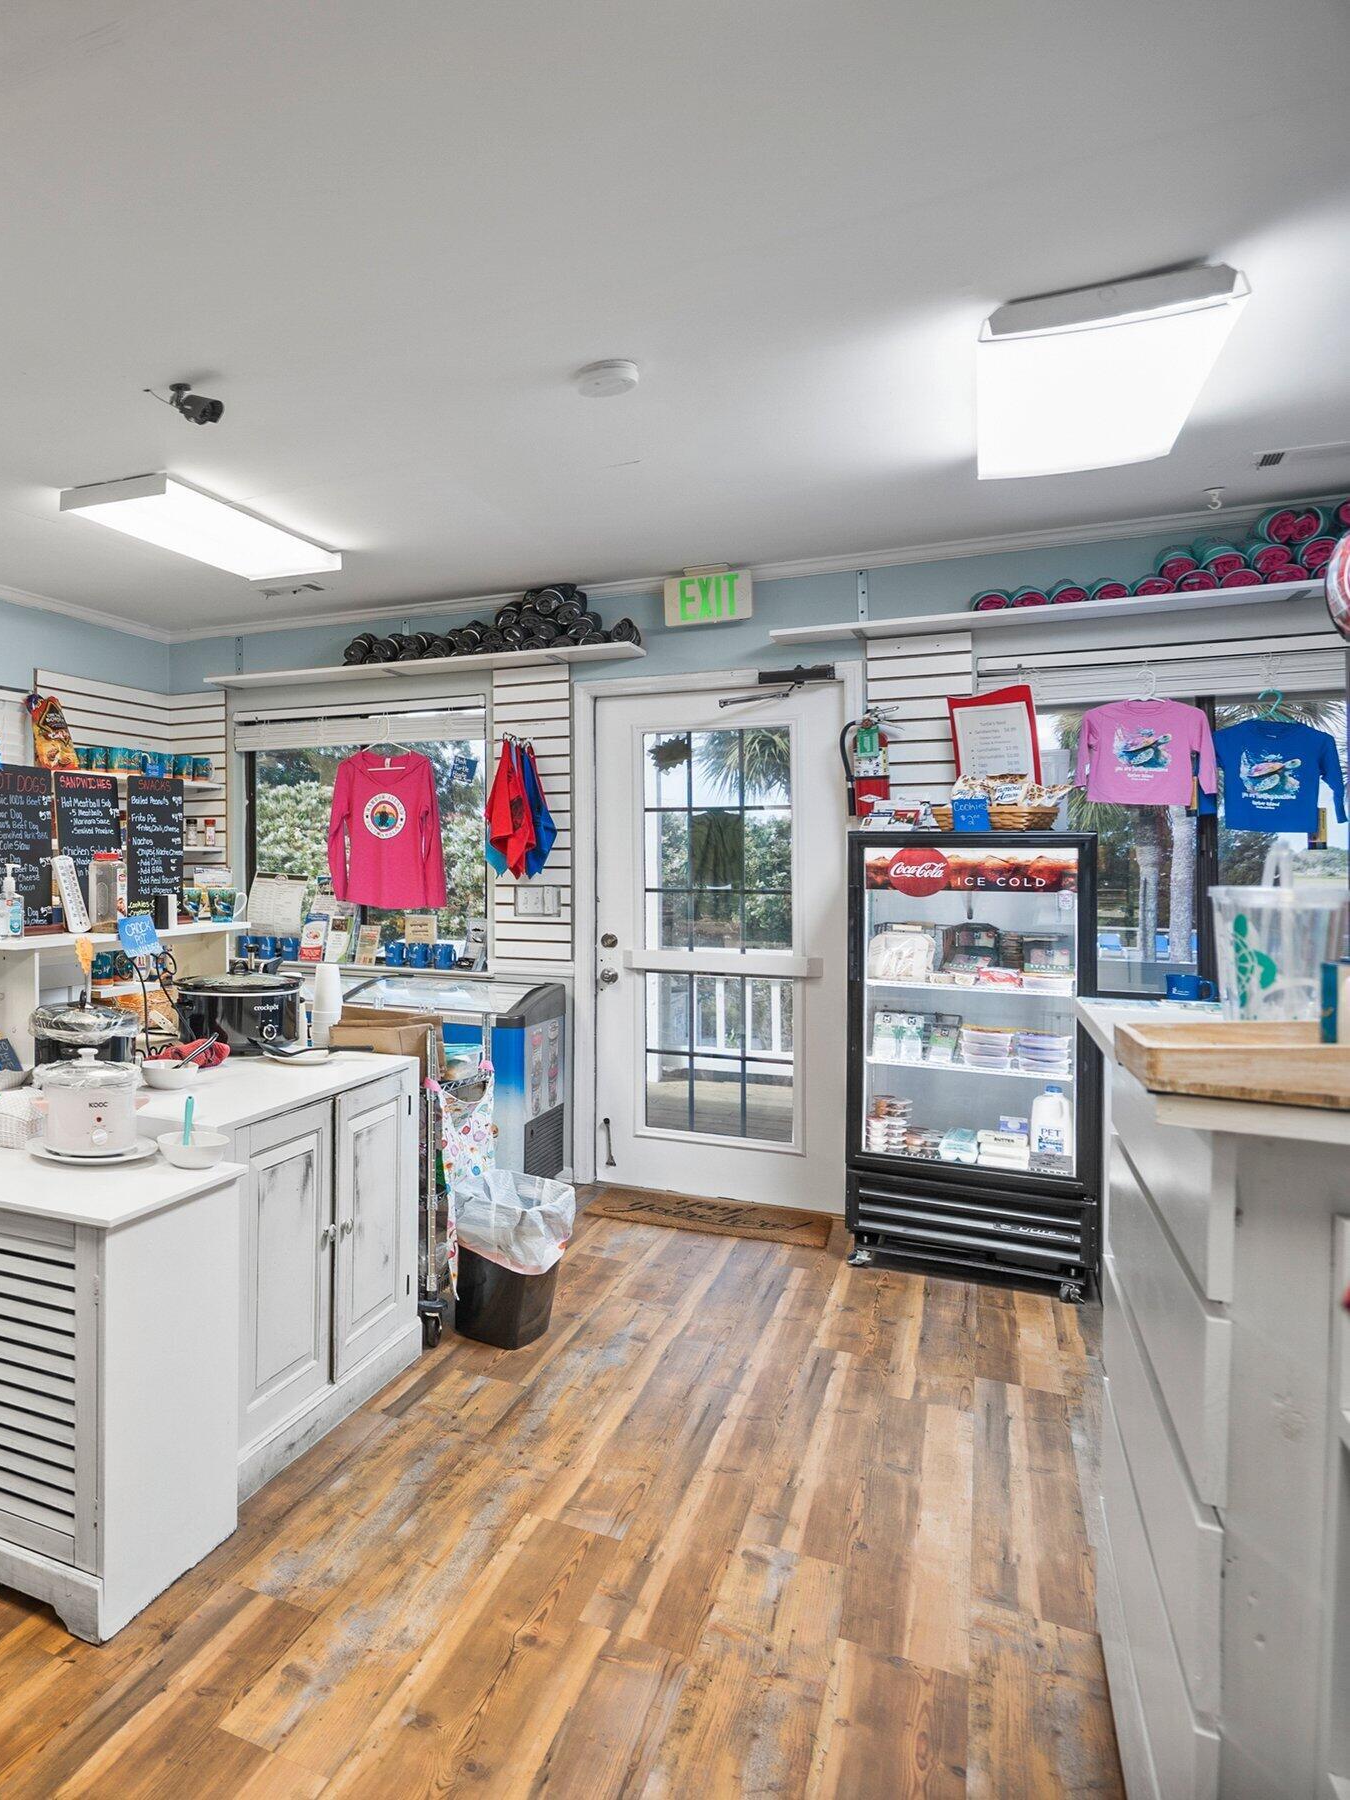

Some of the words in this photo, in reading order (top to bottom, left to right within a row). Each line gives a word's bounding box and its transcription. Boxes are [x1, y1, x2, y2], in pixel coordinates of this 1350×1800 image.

[679, 573, 739, 620] EXIT
[17, 775, 47, 794] DOGS
[60, 775, 113, 790] SANDWICHES
[138, 779, 172, 793] SNACKS
[26, 795, 41, 805] Beef
[61, 796, 72, 808] Hot
[73, 797, 100, 808] Meatball
[101, 798, 111, 808] Sub
[131, 795, 148, 805] Boiled
[953, 801, 987, 812] Cookies
[10, 808, 22, 821] Dog
[131, 812, 146, 822] Frito
[147, 813, 157, 823] Pie
[0, 840, 13, 850] Cole
[14, 840, 30, 851] Slaw
[132, 836, 154, 846] Nachos
[62, 845, 89, 857] Chicken
[10, 853, 21, 865] Dog
[140, 858, 150, 866] Add
[28, 864, 39, 875] Dog
[140, 866, 150, 875] Add
[889, 861, 947, 879] Coca-Cola
[18, 874, 40, 882] Cheese
[140, 876, 150, 884] Add
[957, 877, 985, 886] ICE
[996, 877, 1047, 887] COLD
[18, 884, 36, 892] Bacon
[140, 886, 150, 895] Add
[27, 906, 39, 919] Dog
[253, 1004, 279, 1012] crockpot
[1040, 1127, 1062, 1137] PET
